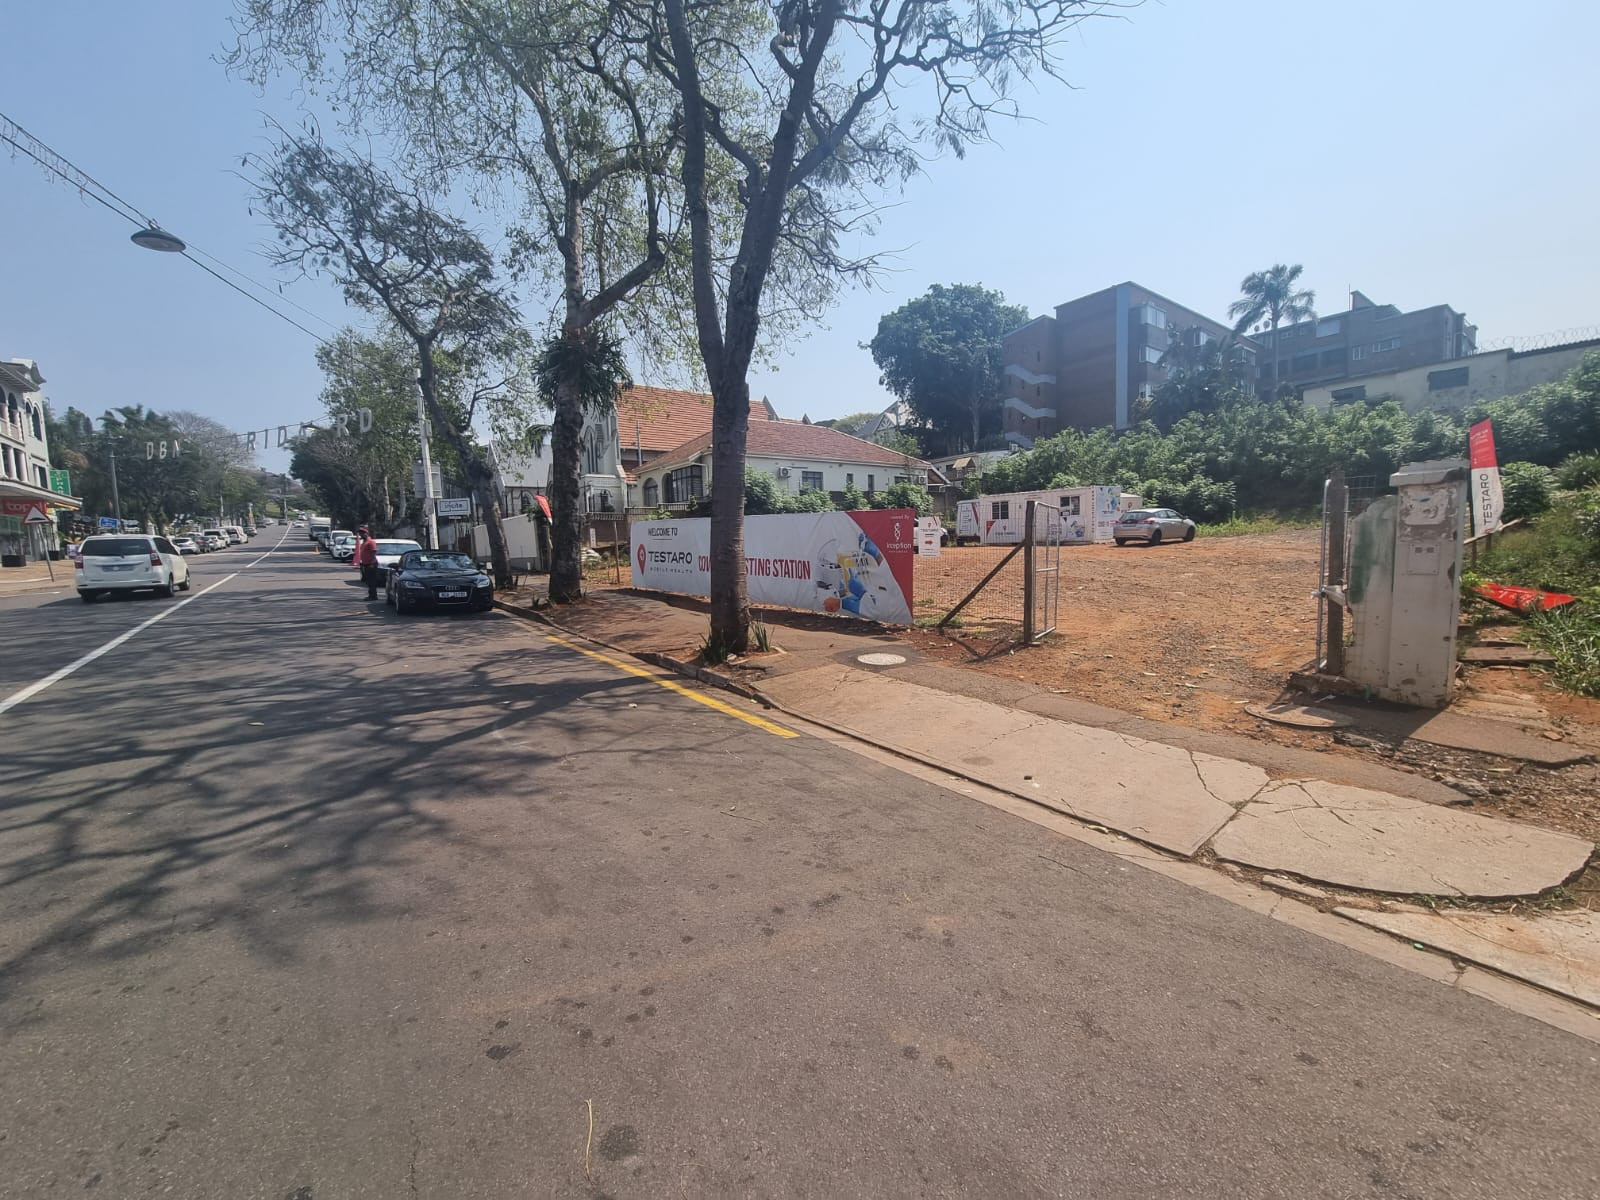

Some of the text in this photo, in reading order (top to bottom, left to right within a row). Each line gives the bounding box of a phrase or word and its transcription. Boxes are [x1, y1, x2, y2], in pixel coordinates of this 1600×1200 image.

[146, 439, 180, 460] DBN
[336, 407, 373, 438] RD
[1479, 473, 1492, 526] TESTARO
[648, 528, 678, 536] WELCOME TO
[648, 551, 693, 564] TESTARO
[773, 559, 811, 580] STATION
